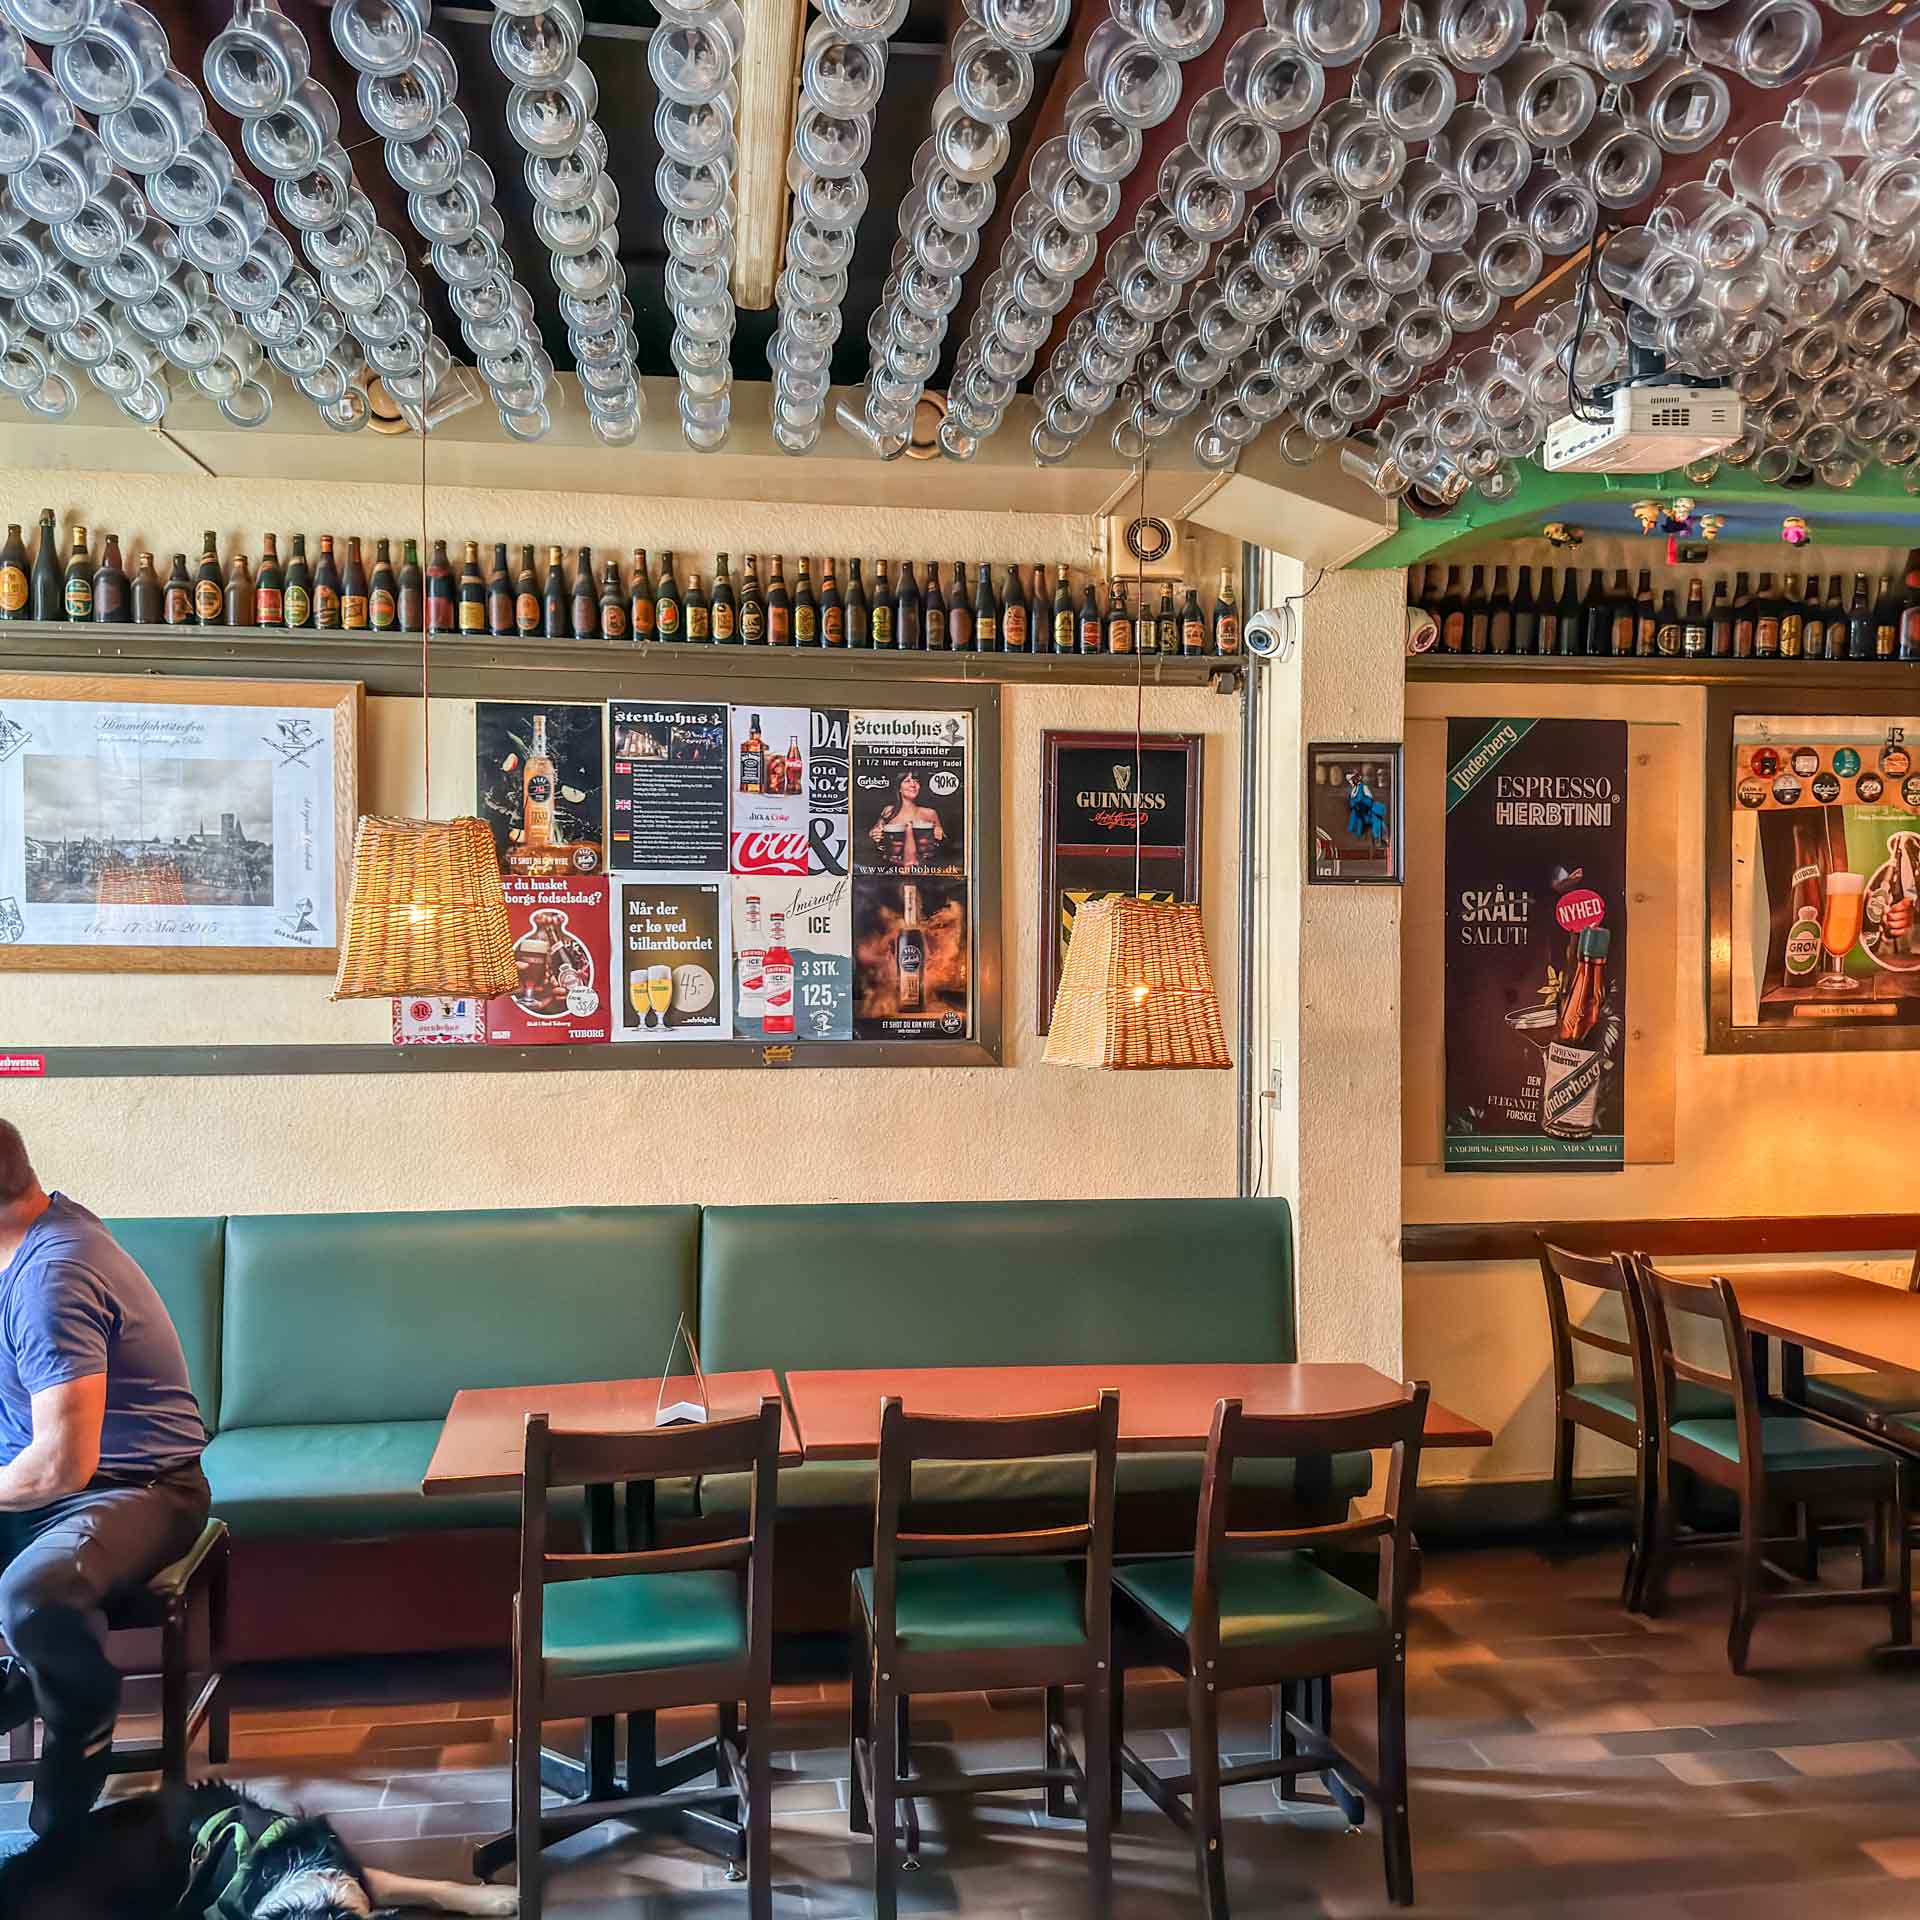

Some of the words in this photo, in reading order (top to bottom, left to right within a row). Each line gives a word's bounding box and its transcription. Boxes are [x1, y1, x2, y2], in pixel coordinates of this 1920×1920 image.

[854, 719, 942, 742] Stenbohus
[867, 745, 950, 756] Torsdagskander
[1451, 724, 1518, 792] Underberg
[866, 759, 879, 768] 1/2
[882, 759, 900, 768] liter
[903, 759, 939, 770] Carlsberg
[856, 775, 890, 790] Carlsberg
[1496, 776, 1611, 798] ESPRESSO
[1076, 792, 1166, 809] GUINNESS
[1496, 802, 1611, 826] HERBTINI
[808, 817, 848, 875] &
[859, 865, 960, 874] www.stenbohus.dk
[514, 878, 528, 890] du
[531, 878, 568, 890] husket
[504, 892, 536, 906] borgs
[784, 880, 848, 918] Smirnoff
[1461, 884, 1528, 922] SKÅL!
[630, 900, 654, 916] Når
[657, 902, 678, 916] der
[1558, 898, 1602, 924] NYHED
[630, 922, 644, 932] er
[664, 919, 688, 932] ved
[808, 916, 831, 934] ICE
[630, 936, 712, 950] billardbordet
[1461, 926, 1528, 945] SALUT!
[1789, 941, 1817, 953] GRØN
[801, 961, 810, 976] 3
[812, 961, 840, 976] STK.
[801, 984, 847, 1009] 125,-
[568, 1029, 604, 1038] TUBORG
[1528, 1076, 1541, 1086] DEN
[1521, 1087, 1540, 1098] LILLE
[1544, 1061, 1601, 1120] Underberg
[1506, 1109, 1537, 1122] FORSKEL
